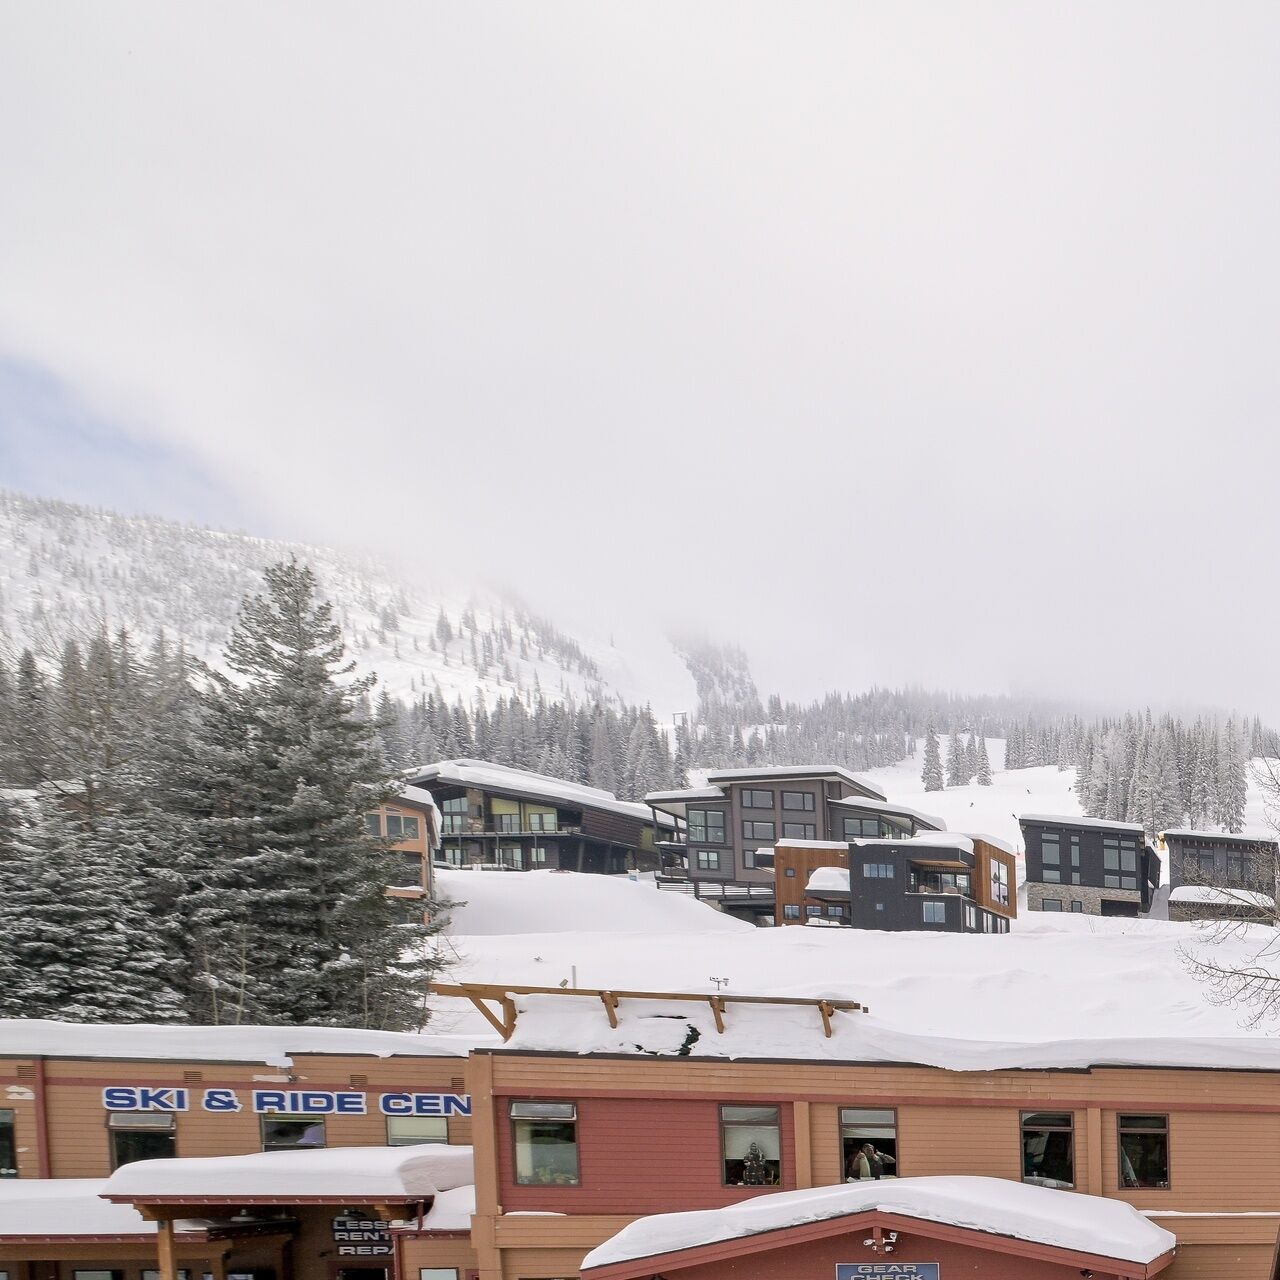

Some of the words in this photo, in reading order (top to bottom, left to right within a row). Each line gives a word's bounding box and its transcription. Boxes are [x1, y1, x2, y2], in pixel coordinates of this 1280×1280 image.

[103, 1087, 188, 1111] SKI
[203, 1090, 243, 1112] &
[253, 1091, 367, 1114] RIDE
[379, 1093, 472, 1116] CEN
[333, 1220, 388, 1230] LESS
[858, 1265, 917, 1273] GEAR
